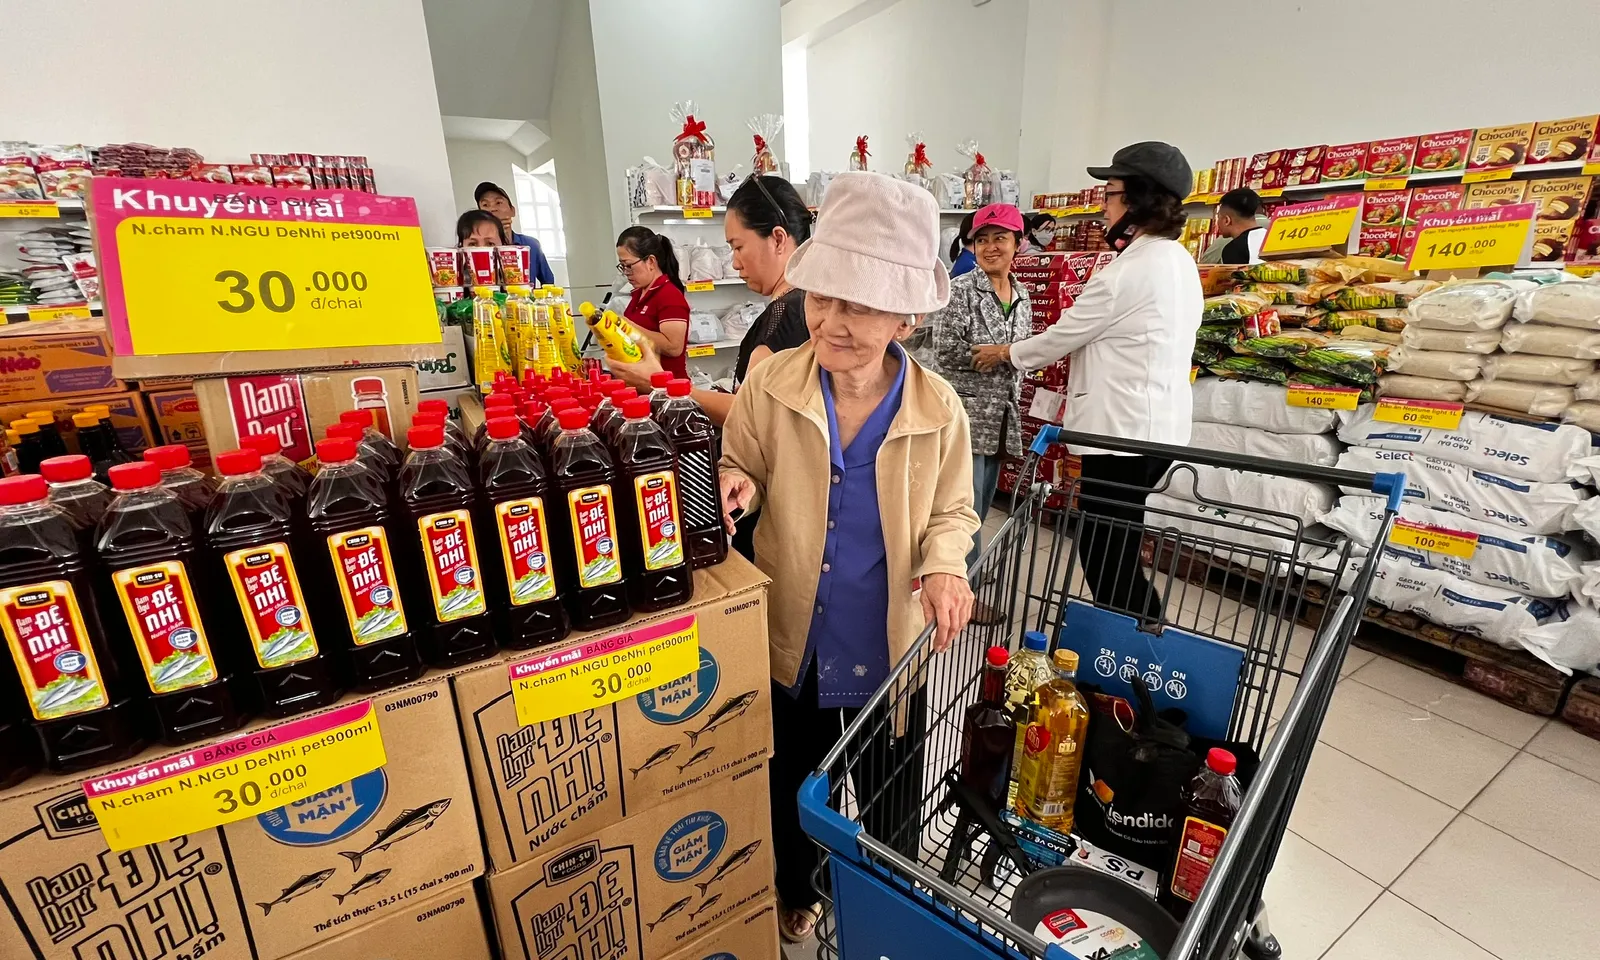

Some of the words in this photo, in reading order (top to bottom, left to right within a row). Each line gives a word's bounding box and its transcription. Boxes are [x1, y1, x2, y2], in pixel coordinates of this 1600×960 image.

[1477, 128, 1528, 142] ChocoPie
[1537, 121, 1591, 136] ChocoPie
[1371, 142, 1414, 155] ChocoPie
[1421, 135, 1469, 149] ChocoPie
[1327, 148, 1365, 160] ChocoPie
[1414, 190, 1461, 202] ChocoPie
[1471, 187, 1520, 197] ChocoPie
[1531, 182, 1584, 194] ChocoPie
[113, 188, 269, 218] Khuyến
[132, 223, 205, 236] N.cham
[211, 224, 270, 237] N.NGU
[276, 226, 326, 239] DeNhi
[332, 229, 400, 242] pet900ml
[1278, 226, 1309, 241] 140
[1427, 241, 1467, 258] 140
[1040, 256, 1051, 266] 90
[1077, 268, 1086, 277] 90
[215, 270, 295, 314] 30
[305, 271, 368, 292] .000
[1036, 283, 1047, 291] 90
[311, 297, 363, 310] đ/chai
[239, 381, 294, 420] Nam
[1305, 396, 1323, 406] 140
[1403, 412, 1418, 422] 60
[1375, 450, 1415, 462] Select
[1484, 447, 1530, 467] Select
[1482, 508, 1528, 527] Select
[1413, 535, 1436, 549] 100
[1484, 570, 1531, 591] Select
[151, 583, 178, 609] ĐỆ
[723, 598, 761, 617] 03NM00790
[34, 604, 64, 631] ĐỆ
[515, 655, 559, 675] Khuyến
[560, 649, 582, 663] mãi
[616, 632, 635, 647] GIÁ
[519, 671, 567, 691] N.cham
[570, 657, 610, 678] N.NGU
[612, 646, 646, 666] DeNhi
[649, 630, 695, 656] pet900ml
[1100, 647, 1116, 659] YES
[1125, 655, 1139, 665] NO
[1148, 663, 1162, 672] NO
[1171, 670, 1186, 680] NO
[591, 672, 623, 699] 30
[383, 689, 440, 714] 03NM00790
[661, 686, 692, 706] MẶN
[496, 724, 536, 761] Nam
[90, 766, 160, 793] Khuyến
[163, 754, 196, 775] mãi
[203, 741, 247, 762] BẢNG
[251, 732, 277, 747] GIÁ
[101, 785, 174, 811] N.cham
[178, 763, 239, 791] N.NGU
[245, 746, 297, 771] DeNhi
[301, 721, 373, 756] pet900ml
[213, 780, 262, 815] 30
[265, 764, 307, 790] .000
[269, 780, 308, 799] đ/chai
[297, 802, 346, 824] MẶN
[528, 817, 568, 852] Nước
[570, 790, 609, 822] chấm
[673, 833, 704, 856] GIẢM
[551, 849, 593, 876] CHIN-SU
[675, 846, 704, 868] MẶN
[25, 861, 94, 909] Nam
[313, 919, 333, 933] Thể
[333, 914, 352, 927] tích
[352, 903, 376, 918] thực:
[376, 896, 397, 909] 13,5
[398, 892, 404, 900] L
[403, 885, 419, 900] (15
[418, 878, 438, 892] chai
[438, 877, 444, 885] x
[443, 870, 460, 883] 900
[460, 863, 475, 877] ml)
[416, 896, 466, 924] 03NM00790
[530, 902, 566, 937] Nam
